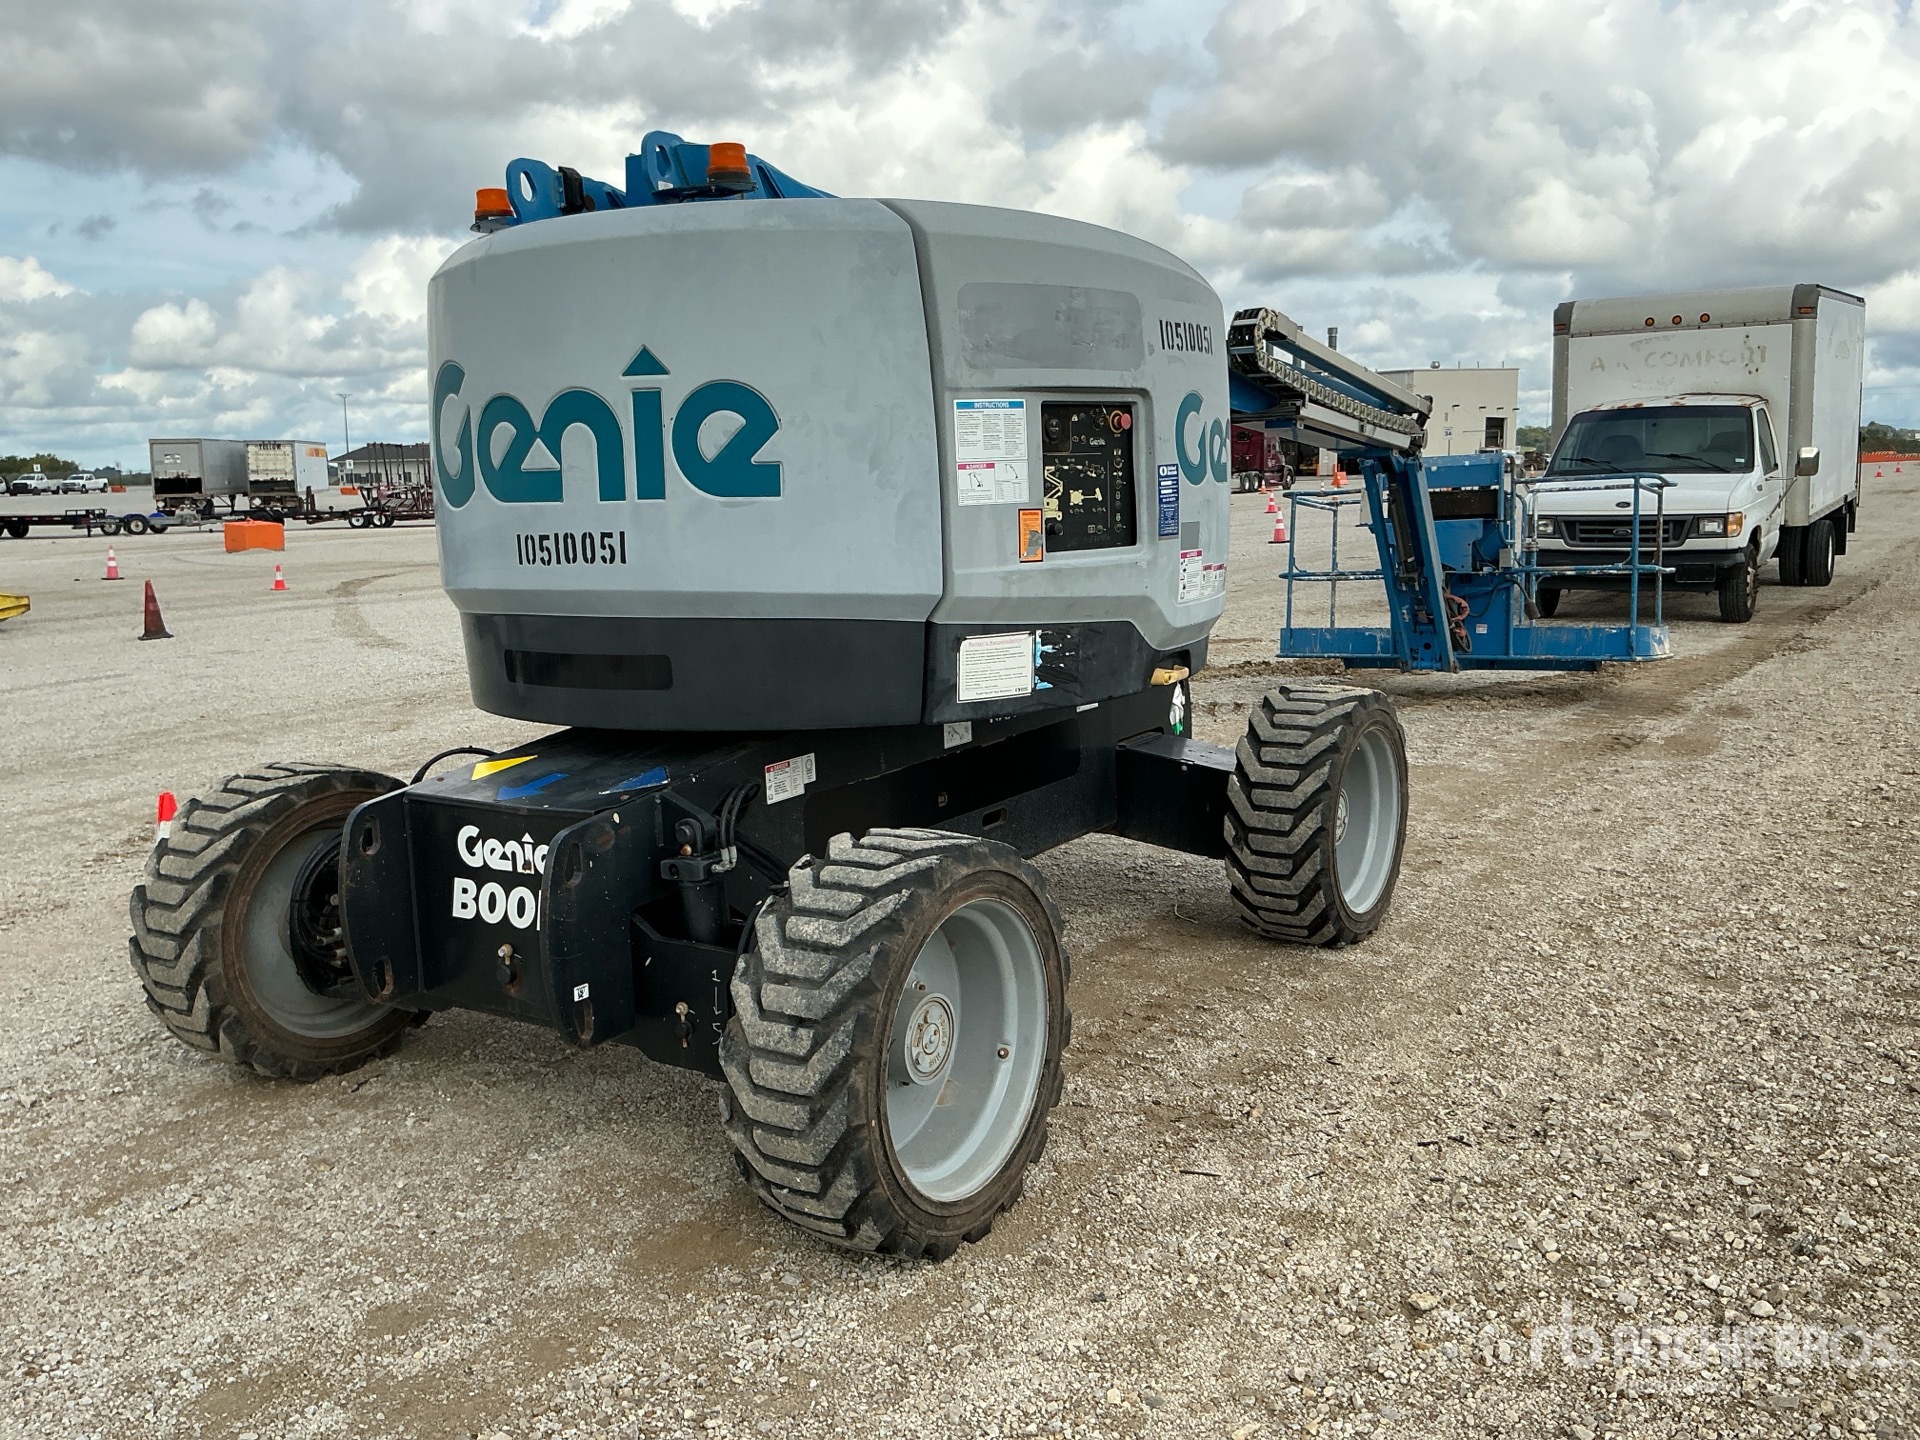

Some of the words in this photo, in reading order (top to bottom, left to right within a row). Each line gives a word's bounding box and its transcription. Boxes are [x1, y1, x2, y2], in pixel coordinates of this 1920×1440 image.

[1159, 319, 1213, 355] 10510051
[434, 344, 783, 509] Genie
[973, 401, 1010, 409] INSTRUCTIONS
[1175, 391, 1229, 485] Ge
[516, 530, 627, 566] 10510051
[452, 877, 541, 931] BOO
